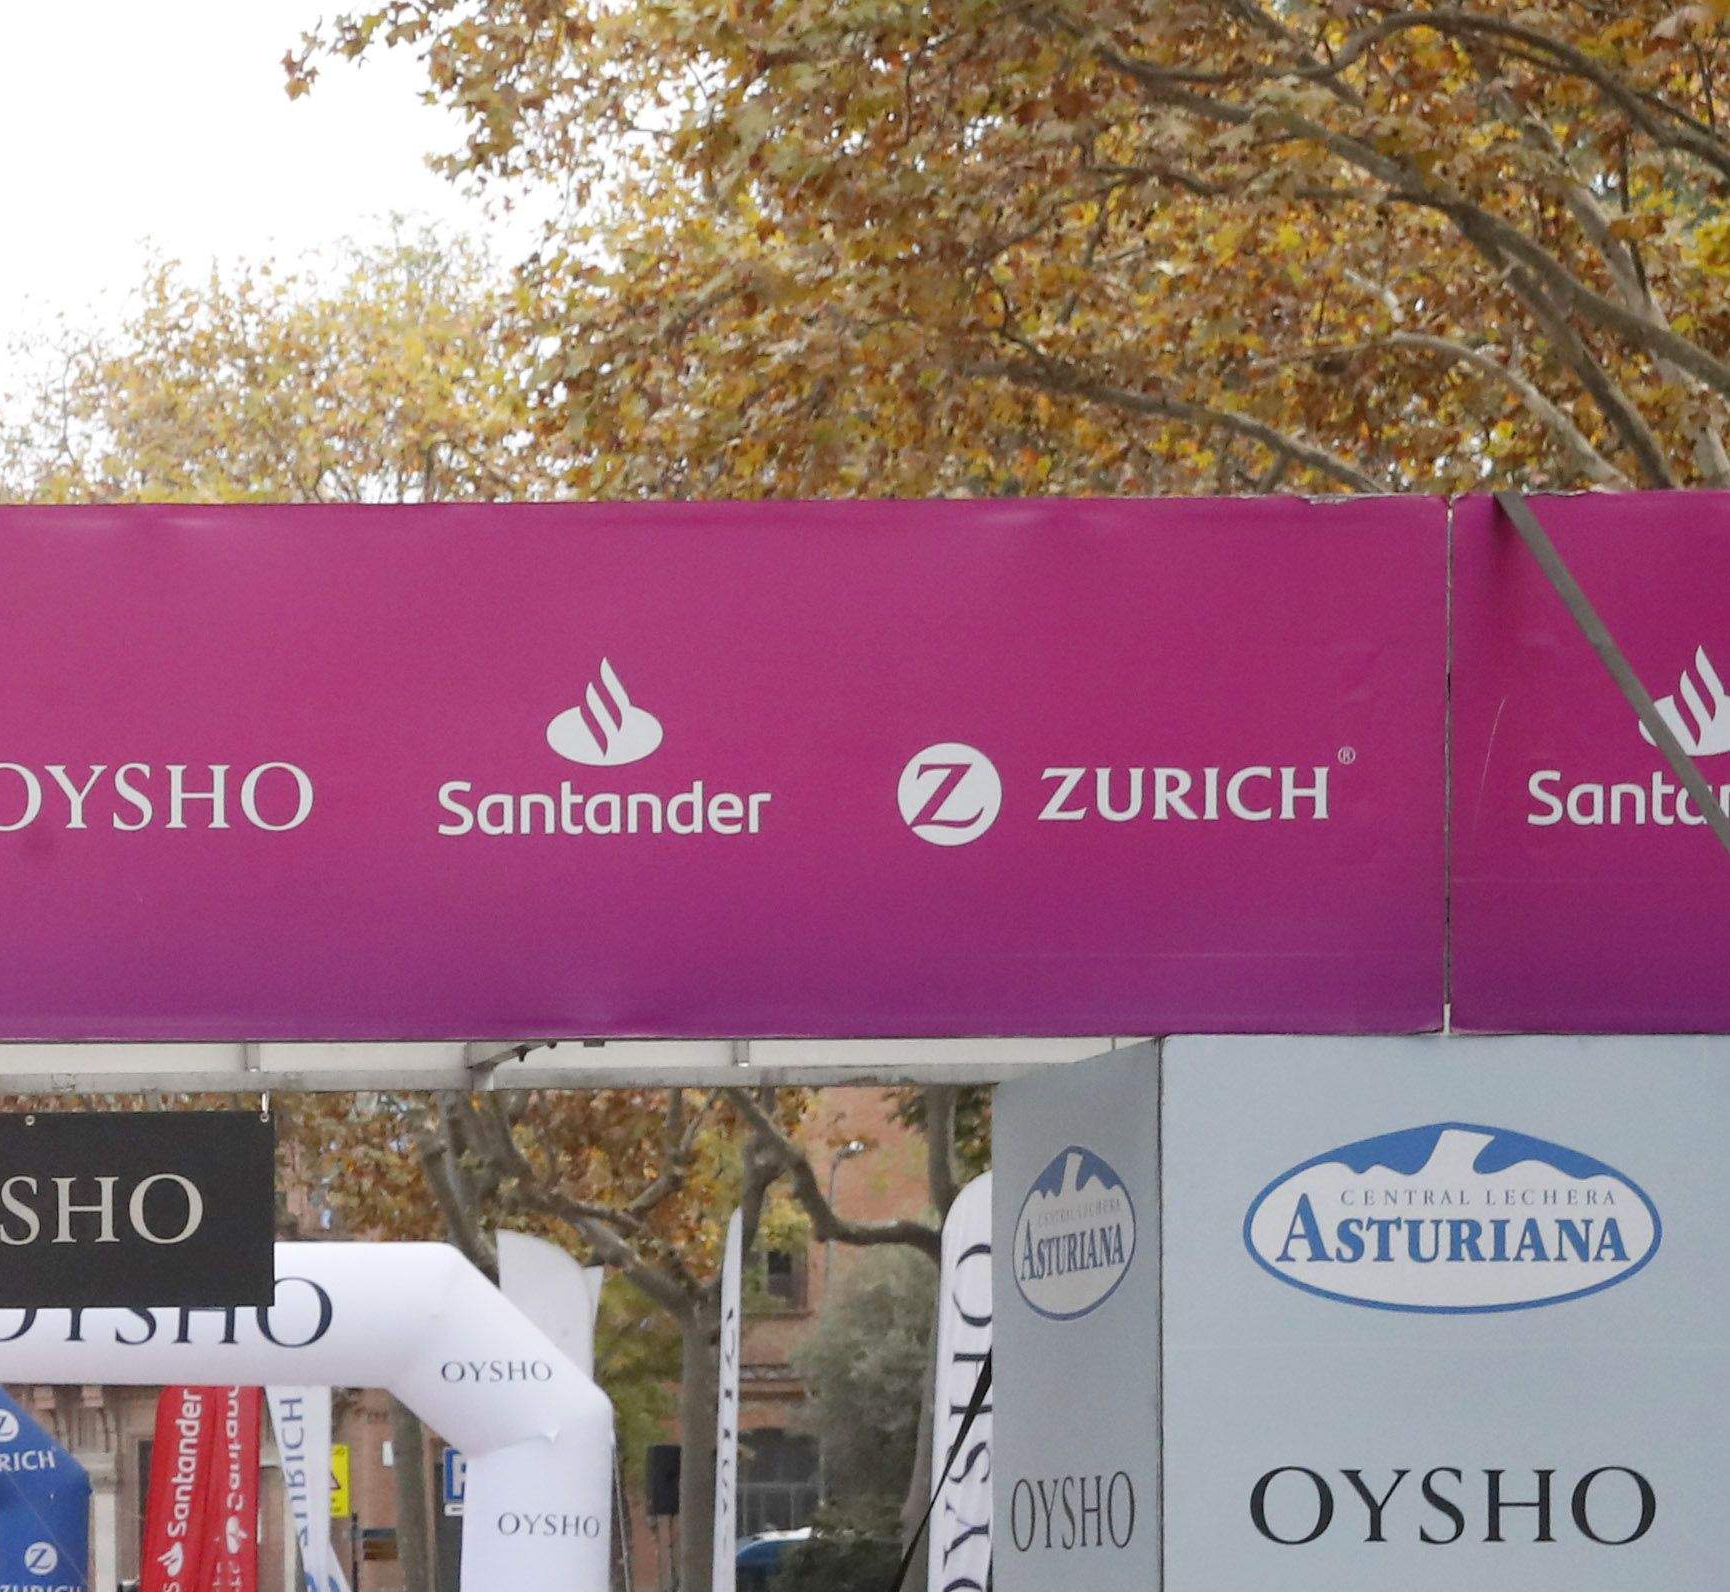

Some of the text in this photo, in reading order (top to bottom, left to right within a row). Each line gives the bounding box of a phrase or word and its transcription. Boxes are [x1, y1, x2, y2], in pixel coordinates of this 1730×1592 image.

[438, 780, 771, 836] Santander
[1038, 766, 1329, 822] ZURICH
[1527, 769, 1730, 827] Santa
[1341, 1189, 1616, 1205] CENTRAL LECHERA
[1021, 1218, 1125, 1281] ASTURIANA
[1276, 1193, 1631, 1264] ASTURIANA
[441, 1359, 554, 1384] OYSHO
[167, 1387, 203, 1538] Santander
[497, 1512, 601, 1540] OYSHO
[1011, 1471, 1135, 1552] OYSHO
[1249, 1466, 1657, 1545] OYSHO
